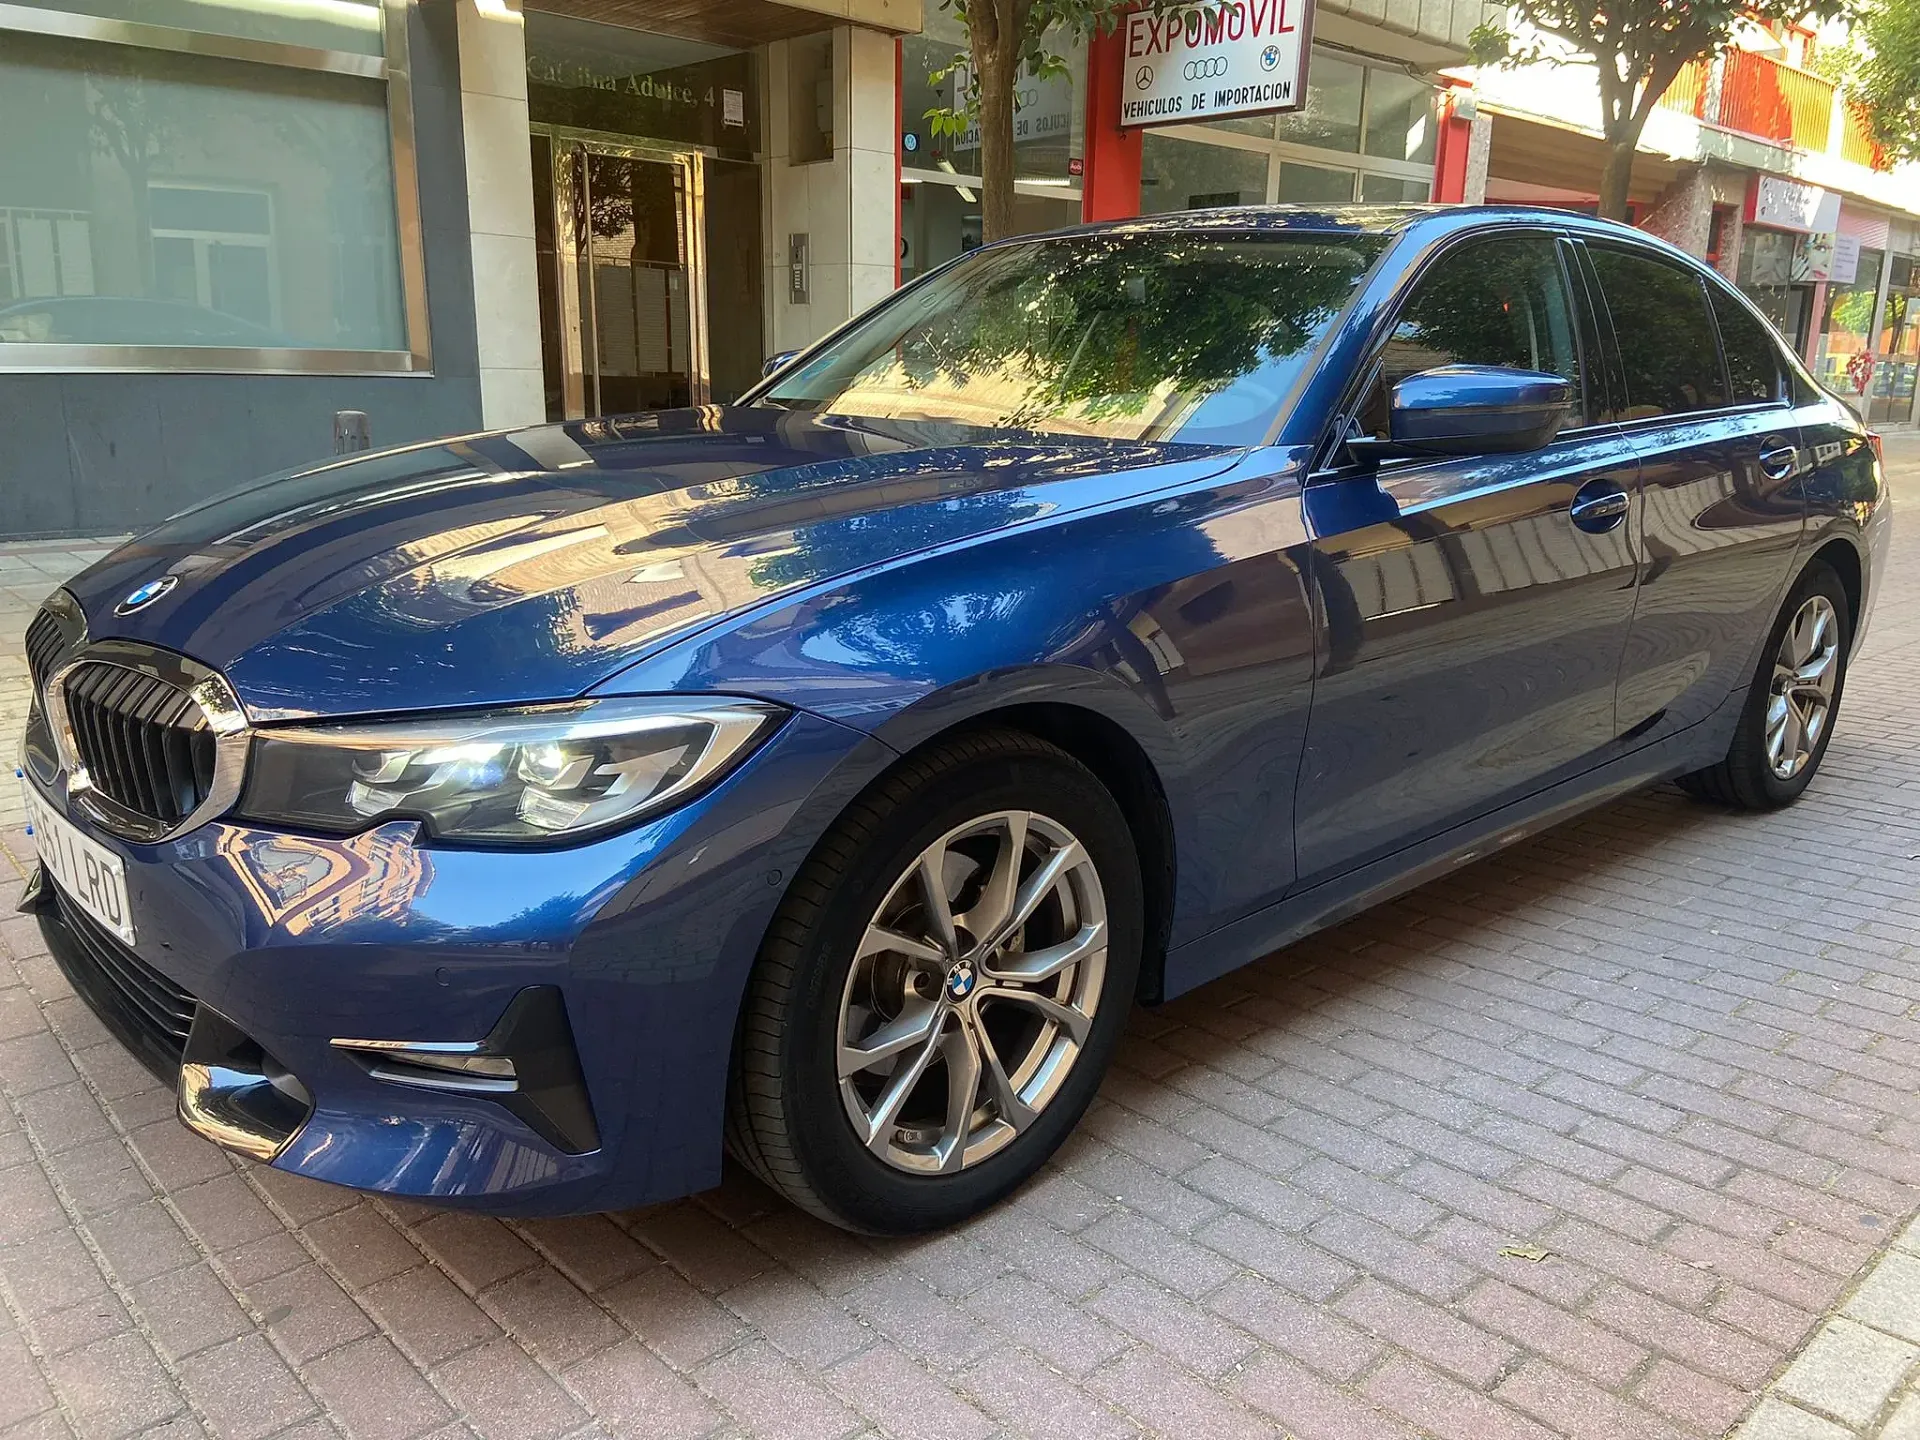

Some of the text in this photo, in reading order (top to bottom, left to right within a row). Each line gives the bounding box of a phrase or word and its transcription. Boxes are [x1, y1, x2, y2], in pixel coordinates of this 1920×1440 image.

[1129, 0, 1295, 58] EXPOMOVIL
[527, 55, 616, 91] Catlina
[704, 86, 715, 107] 4
[1124, 81, 1291, 119] VEHICULOS DE IMPORTACION
[69, 836, 122, 927] LRD
